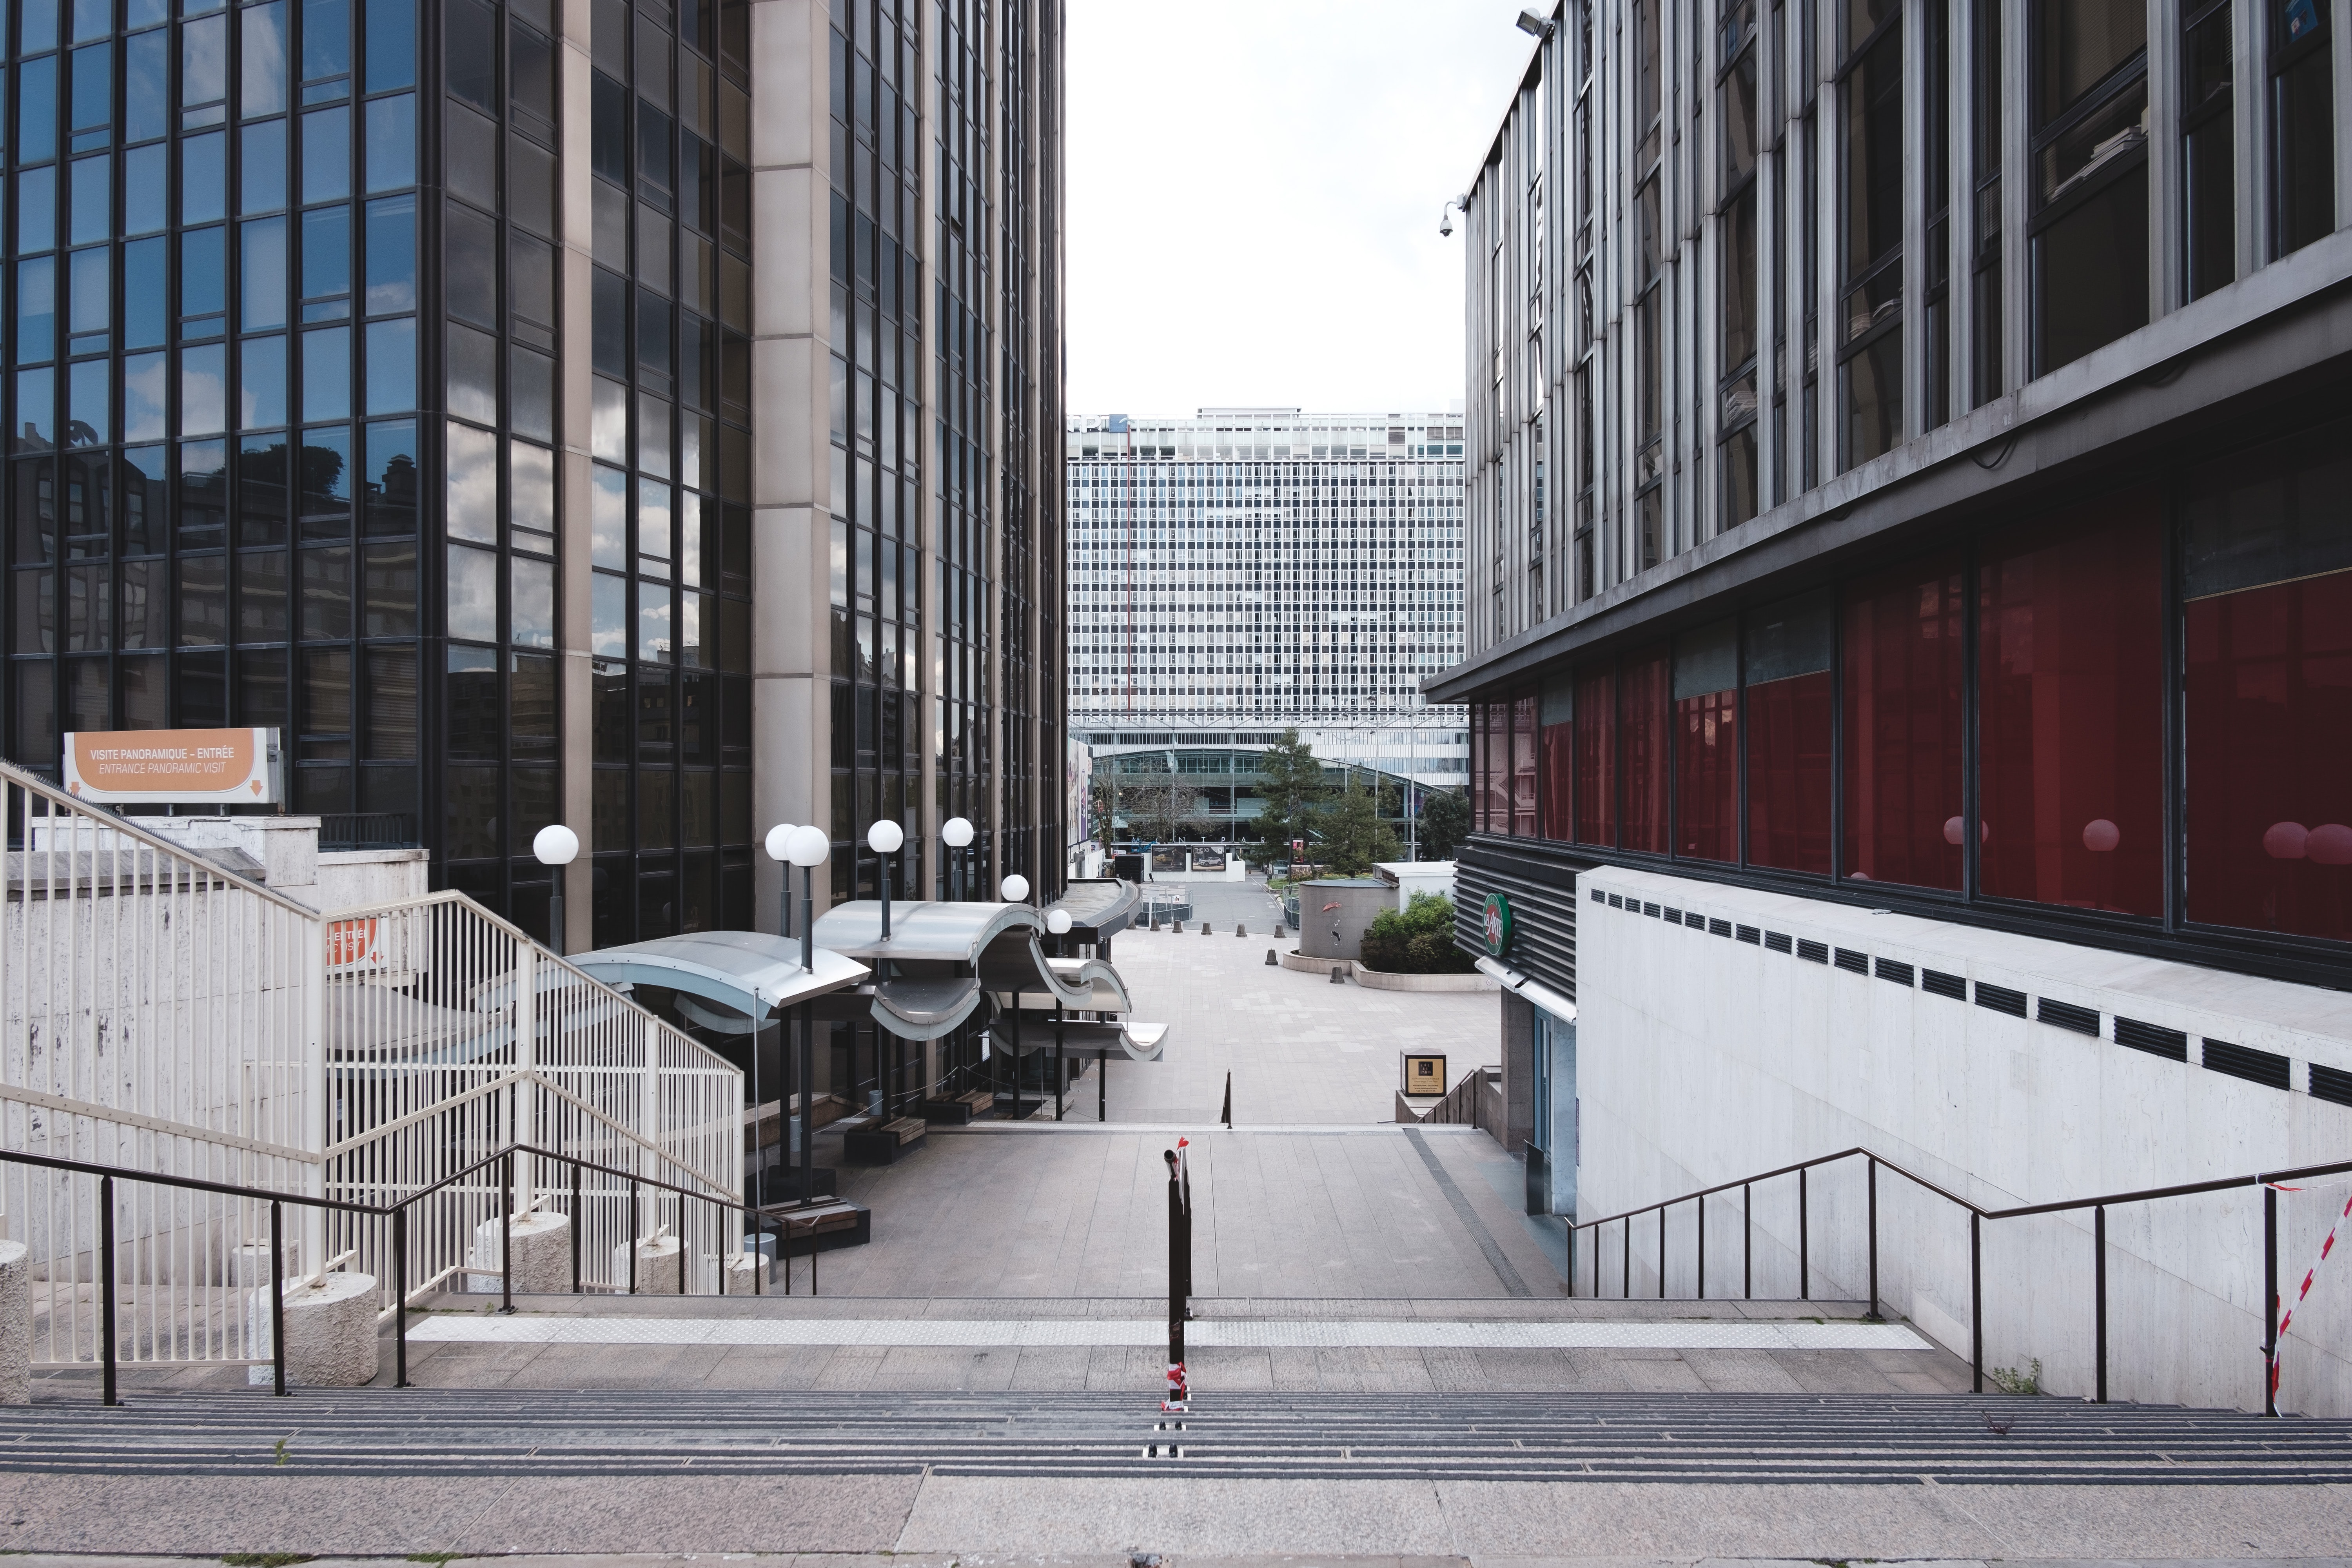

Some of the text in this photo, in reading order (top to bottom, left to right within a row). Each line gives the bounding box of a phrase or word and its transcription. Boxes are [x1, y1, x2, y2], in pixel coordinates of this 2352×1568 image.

[90, 750, 118, 760] VISITE
[121, 748, 187, 760] PANORAMIQUE
[197, 745, 234, 759] ENTRÉE
[99, 762, 227, 774] ENTRANCE PANORAMIC VISIT
[1485, 911, 1502, 946] ARTE
